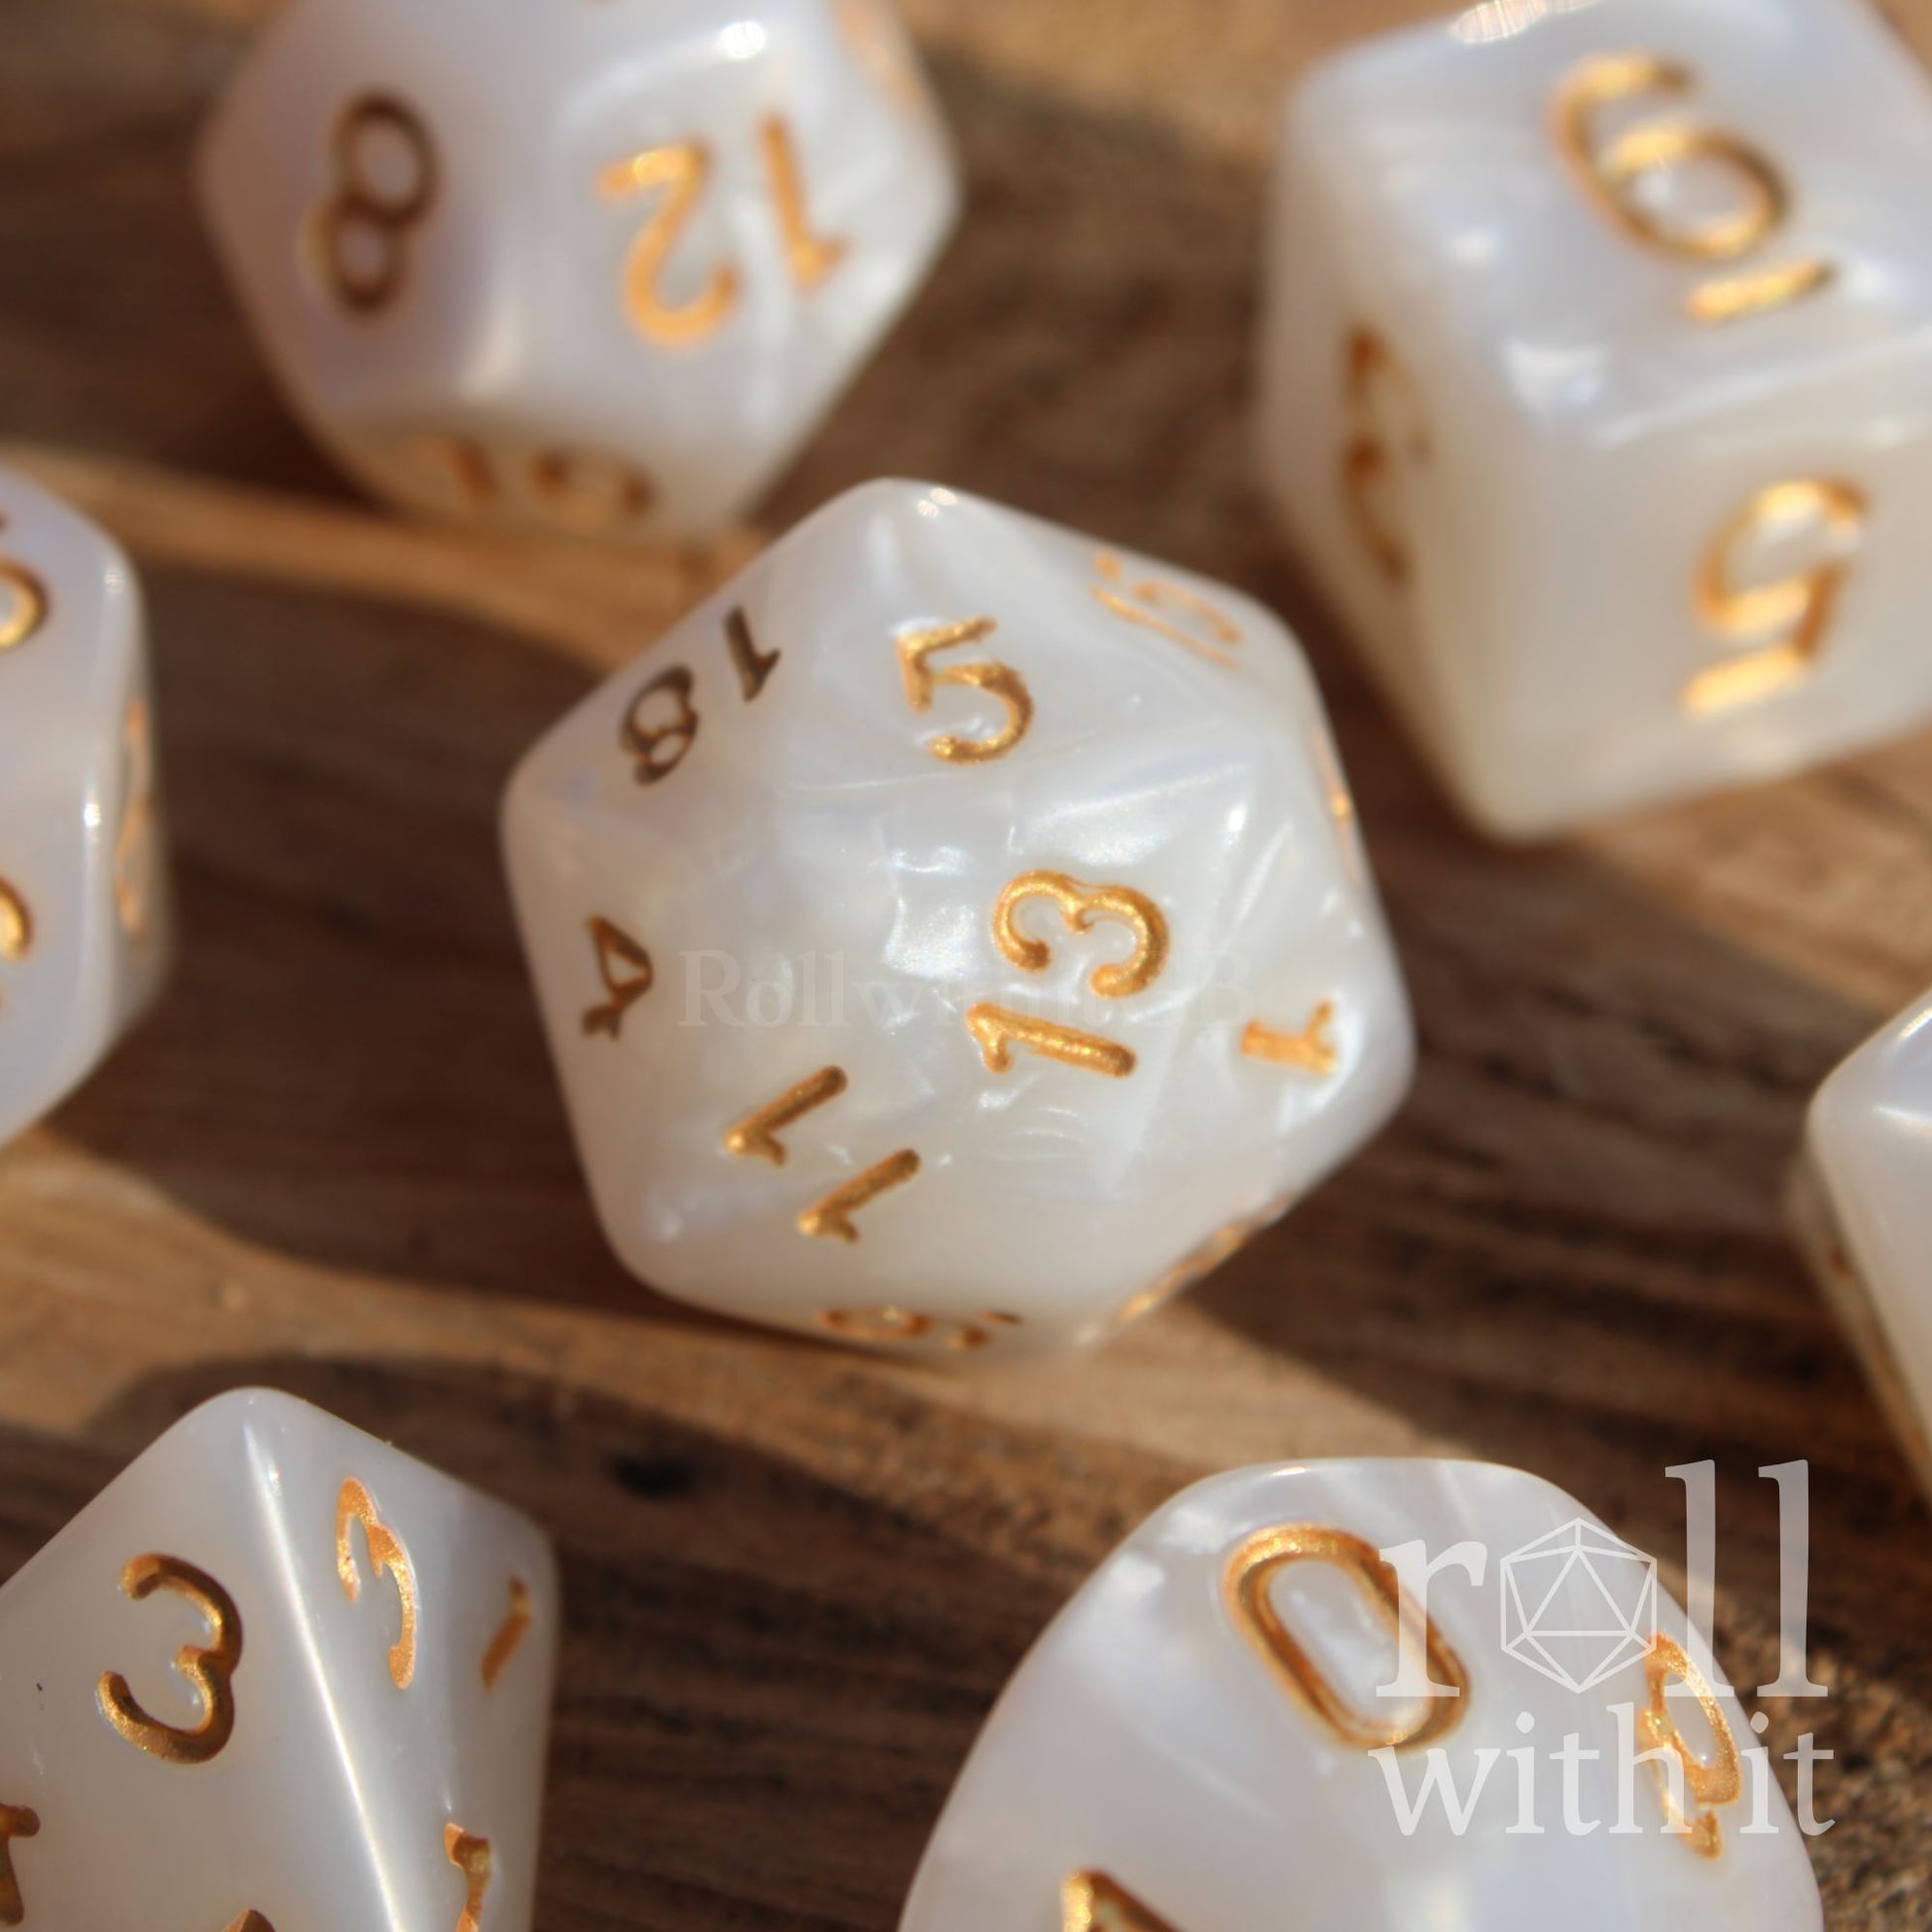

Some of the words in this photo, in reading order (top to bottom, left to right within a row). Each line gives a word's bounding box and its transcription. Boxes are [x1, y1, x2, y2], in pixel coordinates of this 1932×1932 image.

[303, 87, 439, 316] 8
[597, 114, 849, 351] 12
[620, 605, 782, 786] 18
[896, 616, 1035, 765] 5
[582, 915, 653, 1039] 4
[966, 868, 1170, 1079] 13
[722, 1065, 921, 1245] 11
[96, 1552, 243, 1764] 3
[1222, 1521, 1469, 1751] 0
